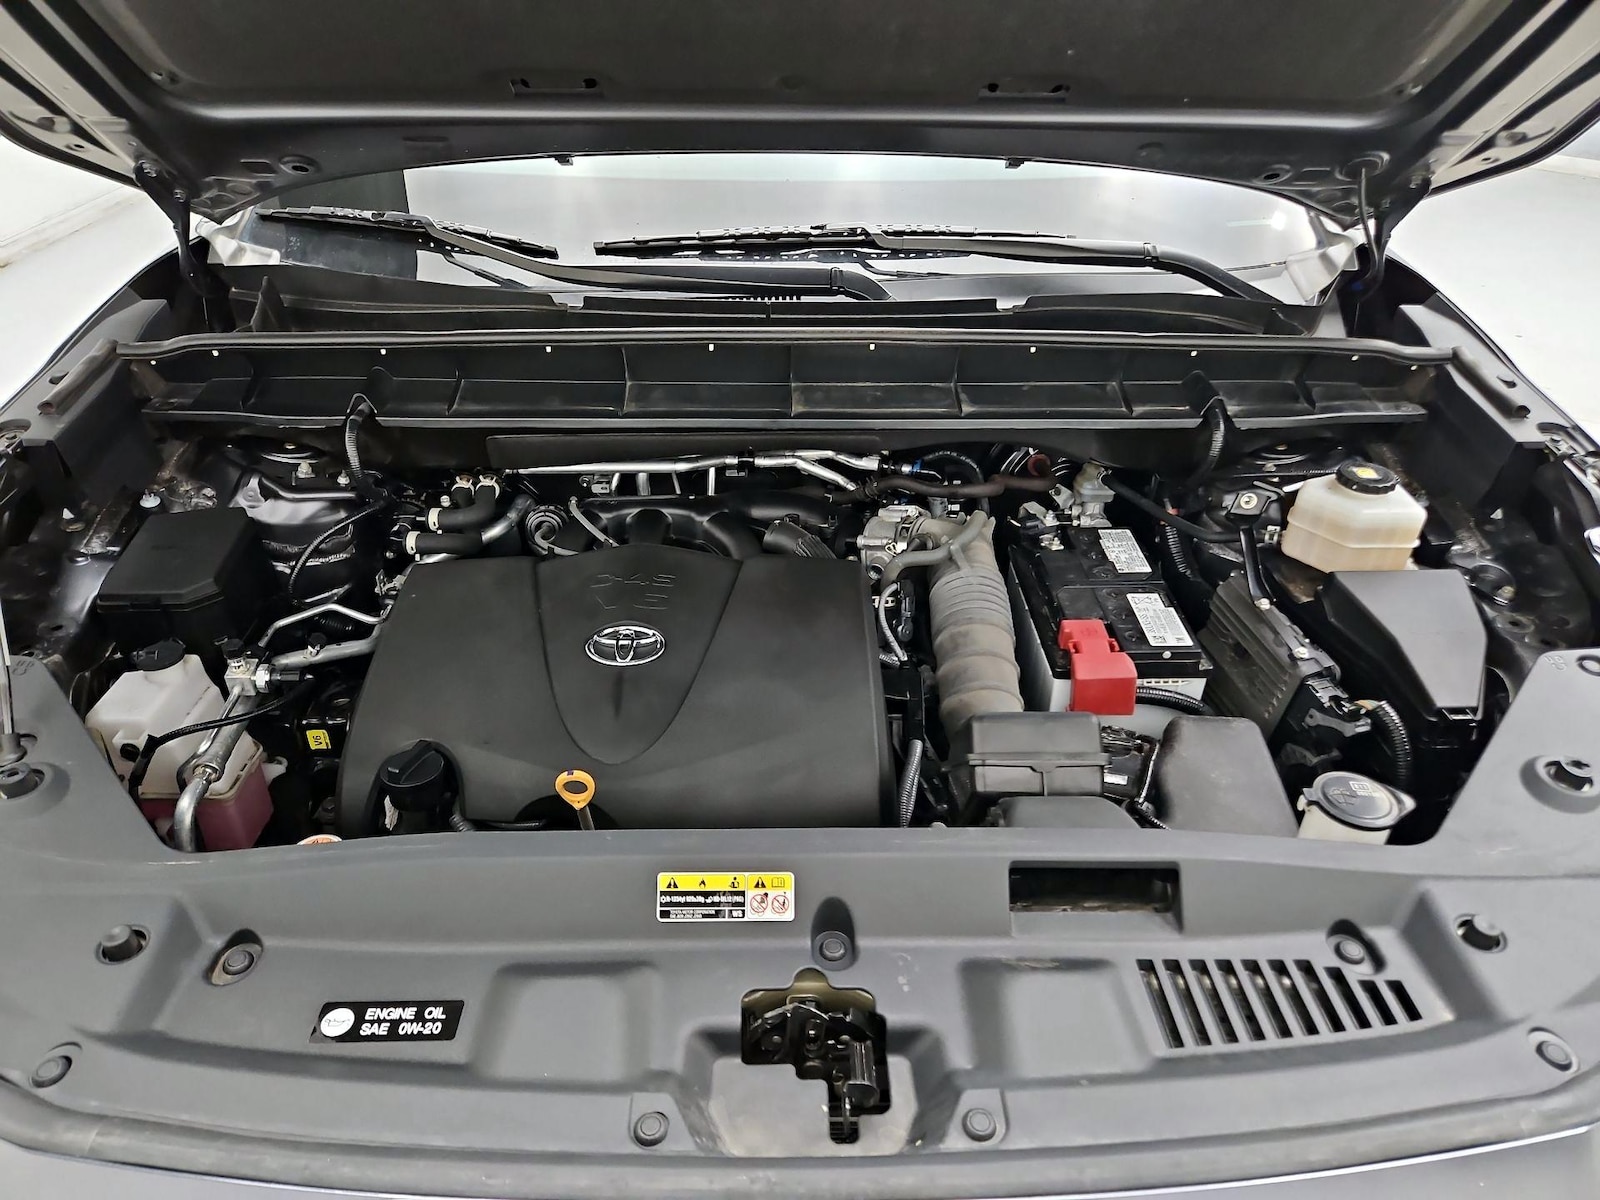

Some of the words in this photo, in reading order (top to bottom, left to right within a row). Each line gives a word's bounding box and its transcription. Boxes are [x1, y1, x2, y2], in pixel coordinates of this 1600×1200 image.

[732, 910, 743, 918] WS
[364, 1006, 418, 1021] ENGINE
[424, 1006, 447, 1020] OIL
[359, 1022, 391, 1036] SAE
[398, 1021, 442, 1036] 0W-20
